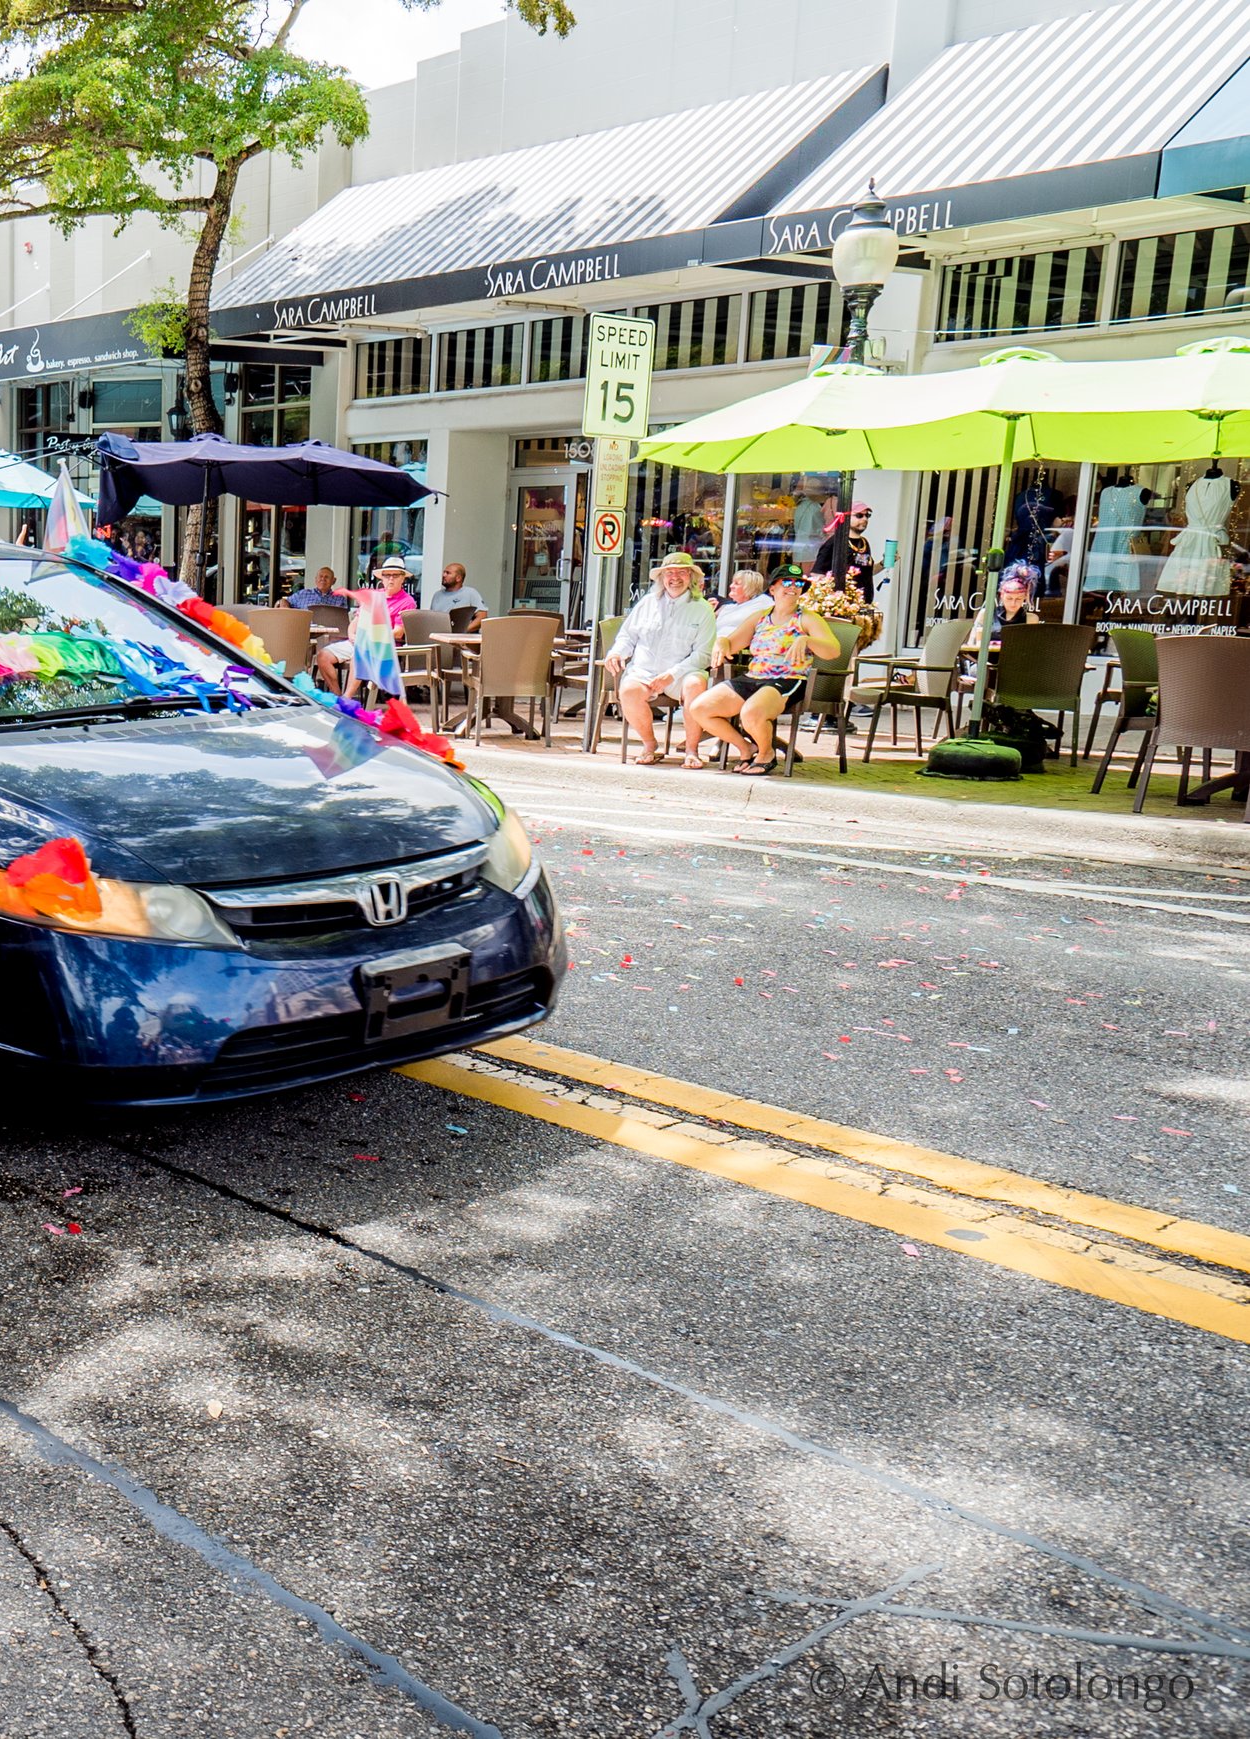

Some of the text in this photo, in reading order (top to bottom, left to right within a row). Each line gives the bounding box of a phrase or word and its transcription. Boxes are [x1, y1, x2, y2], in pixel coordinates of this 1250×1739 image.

[768, 215, 821, 254] SARA
[486, 254, 621, 297] SARA CAMPBELL
[274, 294, 377, 329] SARA CAMPBELL
[596, 324, 648, 347] SPEED
[94, 349, 122, 363] sandwich
[600, 349, 640, 371] LIMIT
[600, 380, 635, 424] 15
[609, 443, 619, 451] NO
[934, 588, 965, 611] SARA
[1105, 591, 1232, 617] SARA CAMPBELL
[1211, 626, 1237, 637] NAPLES
